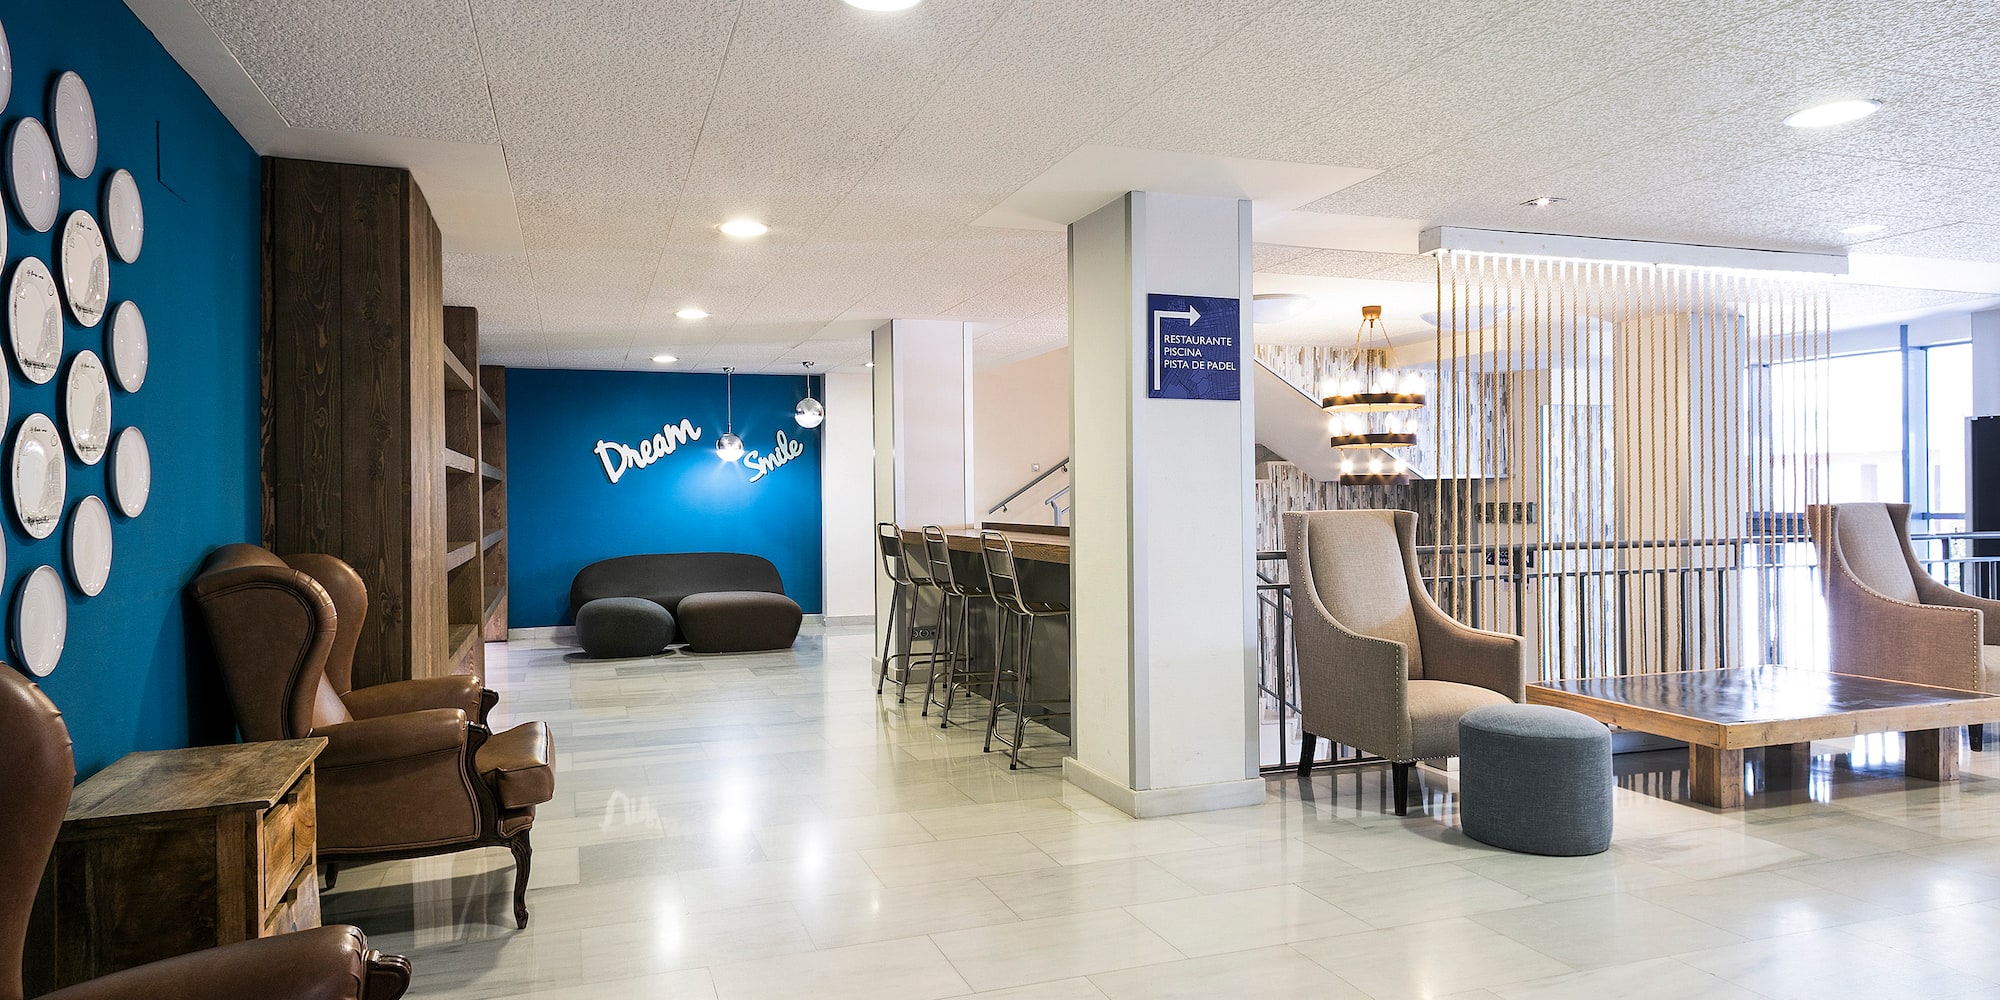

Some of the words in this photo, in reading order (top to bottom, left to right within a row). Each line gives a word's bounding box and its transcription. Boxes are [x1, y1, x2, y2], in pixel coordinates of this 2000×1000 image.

[1164, 334, 1232, 346] RESTAURANTE
[1164, 347, 1202, 357] PISCINA
[1164, 359, 1189, 369] PISTA
[1192, 360, 1205, 370] DE
[1207, 361, 1236, 371] PADEL
[594, 418, 702, 484] Dream
[743, 429, 803, 483] Smile
